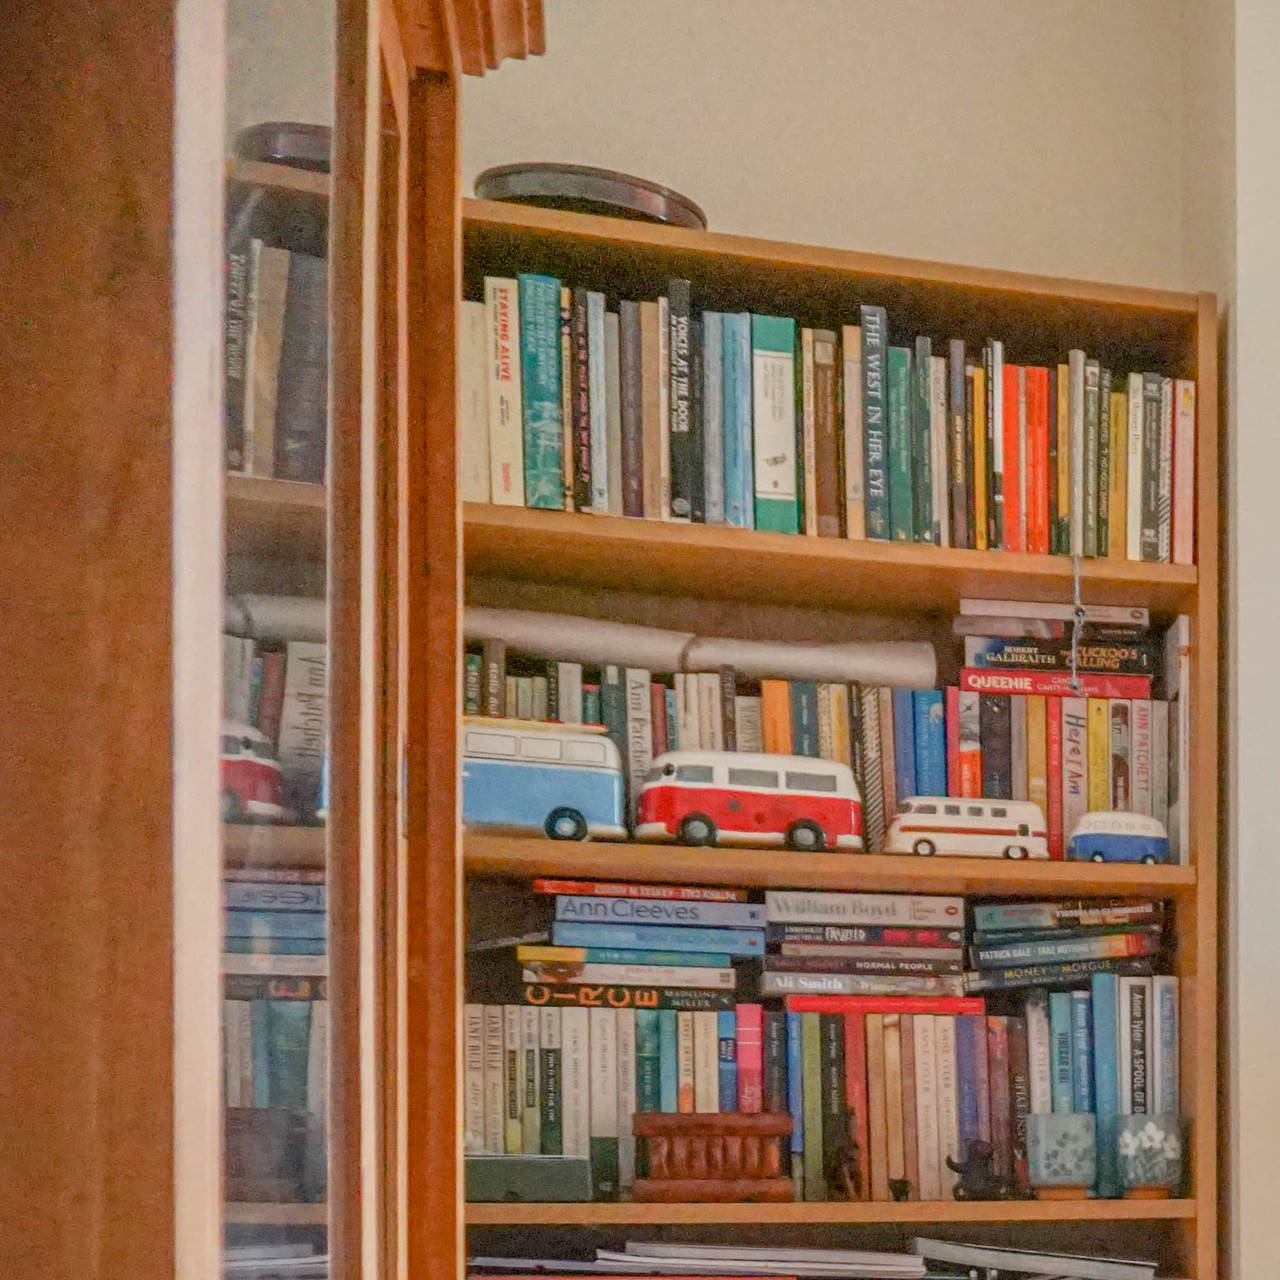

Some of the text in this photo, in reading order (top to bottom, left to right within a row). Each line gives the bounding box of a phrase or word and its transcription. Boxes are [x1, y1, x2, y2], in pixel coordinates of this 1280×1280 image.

[498, 288, 510, 342] STAYING
[500, 345, 512, 382] ALIVE
[678, 376, 689, 396] THE
[865, 314, 884, 499] THE WEST IN HER EYE
[987, 653, 1057, 664] GALBRAITH
[968, 674, 1034, 690] QUEENIE
[1065, 713, 1085, 756] Here
[1136, 706, 1150, 792] ANN PATCHETT
[1068, 770, 1085, 796] Am
[562, 898, 699, 920] Ann Cleeves
[774, 899, 847, 916] William
[856, 961, 897, 970] NORMAL
[899, 962, 933, 971] PEOPLE
[1004, 959, 1112, 979] MONEY MORGUE
[774, 976, 843, 991] Ali Smith
[1133, 993, 1144, 1018] Anne
[1131, 1018, 1144, 1042] Tyler
[1134, 1058, 1145, 1090] SPOOL
[1134, 1091, 1145, 1105] OF
